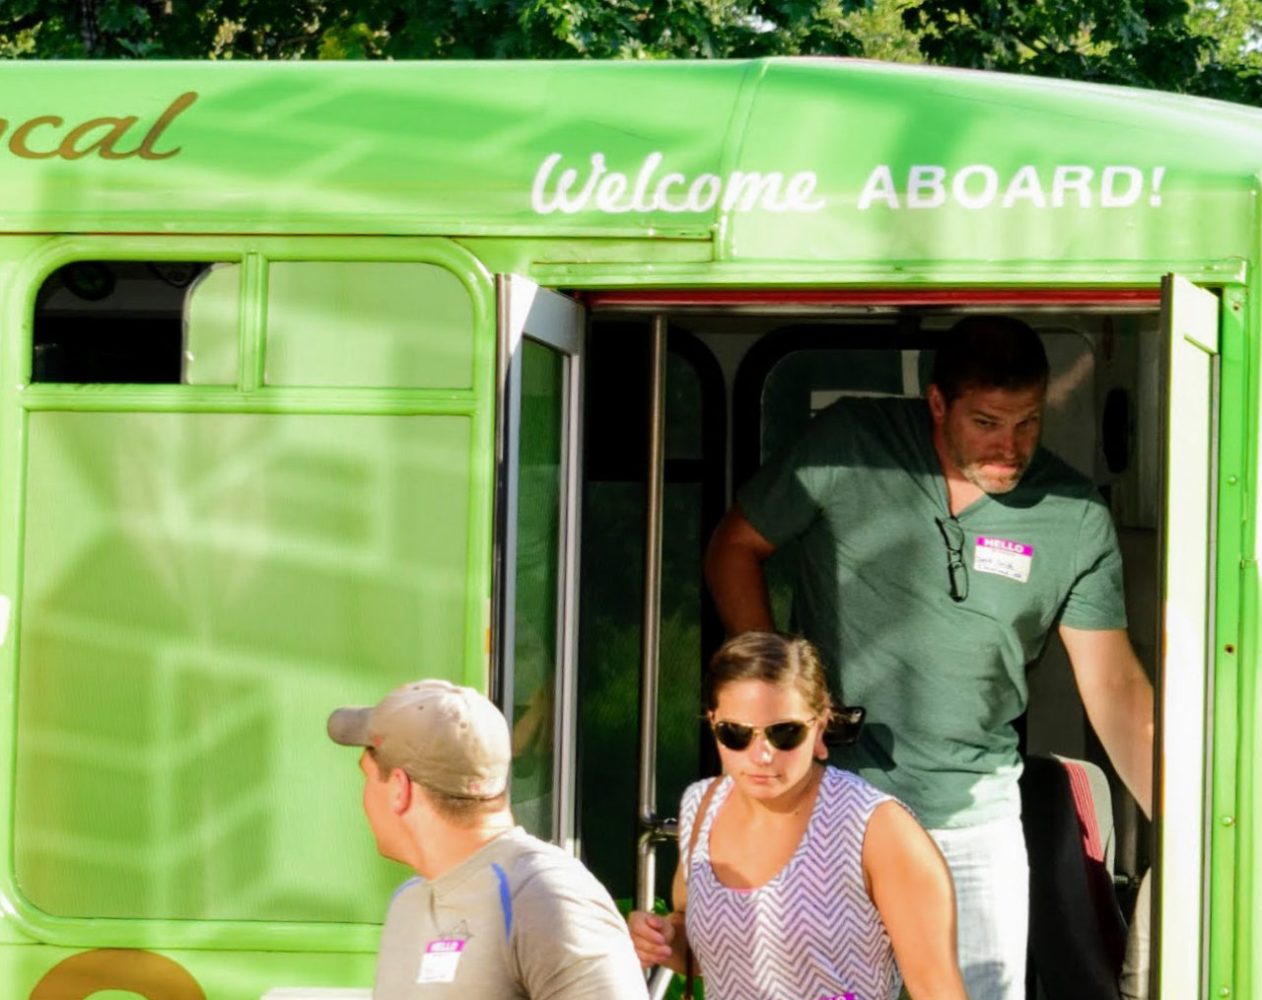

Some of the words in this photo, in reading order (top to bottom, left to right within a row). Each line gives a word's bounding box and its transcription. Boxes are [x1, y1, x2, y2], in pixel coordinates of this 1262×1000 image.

[0, 91, 198, 160] cal
[530, 151, 825, 214] Welcome
[857, 164, 1166, 211] ABOARD!
[985, 538, 1024, 553] HELLO
